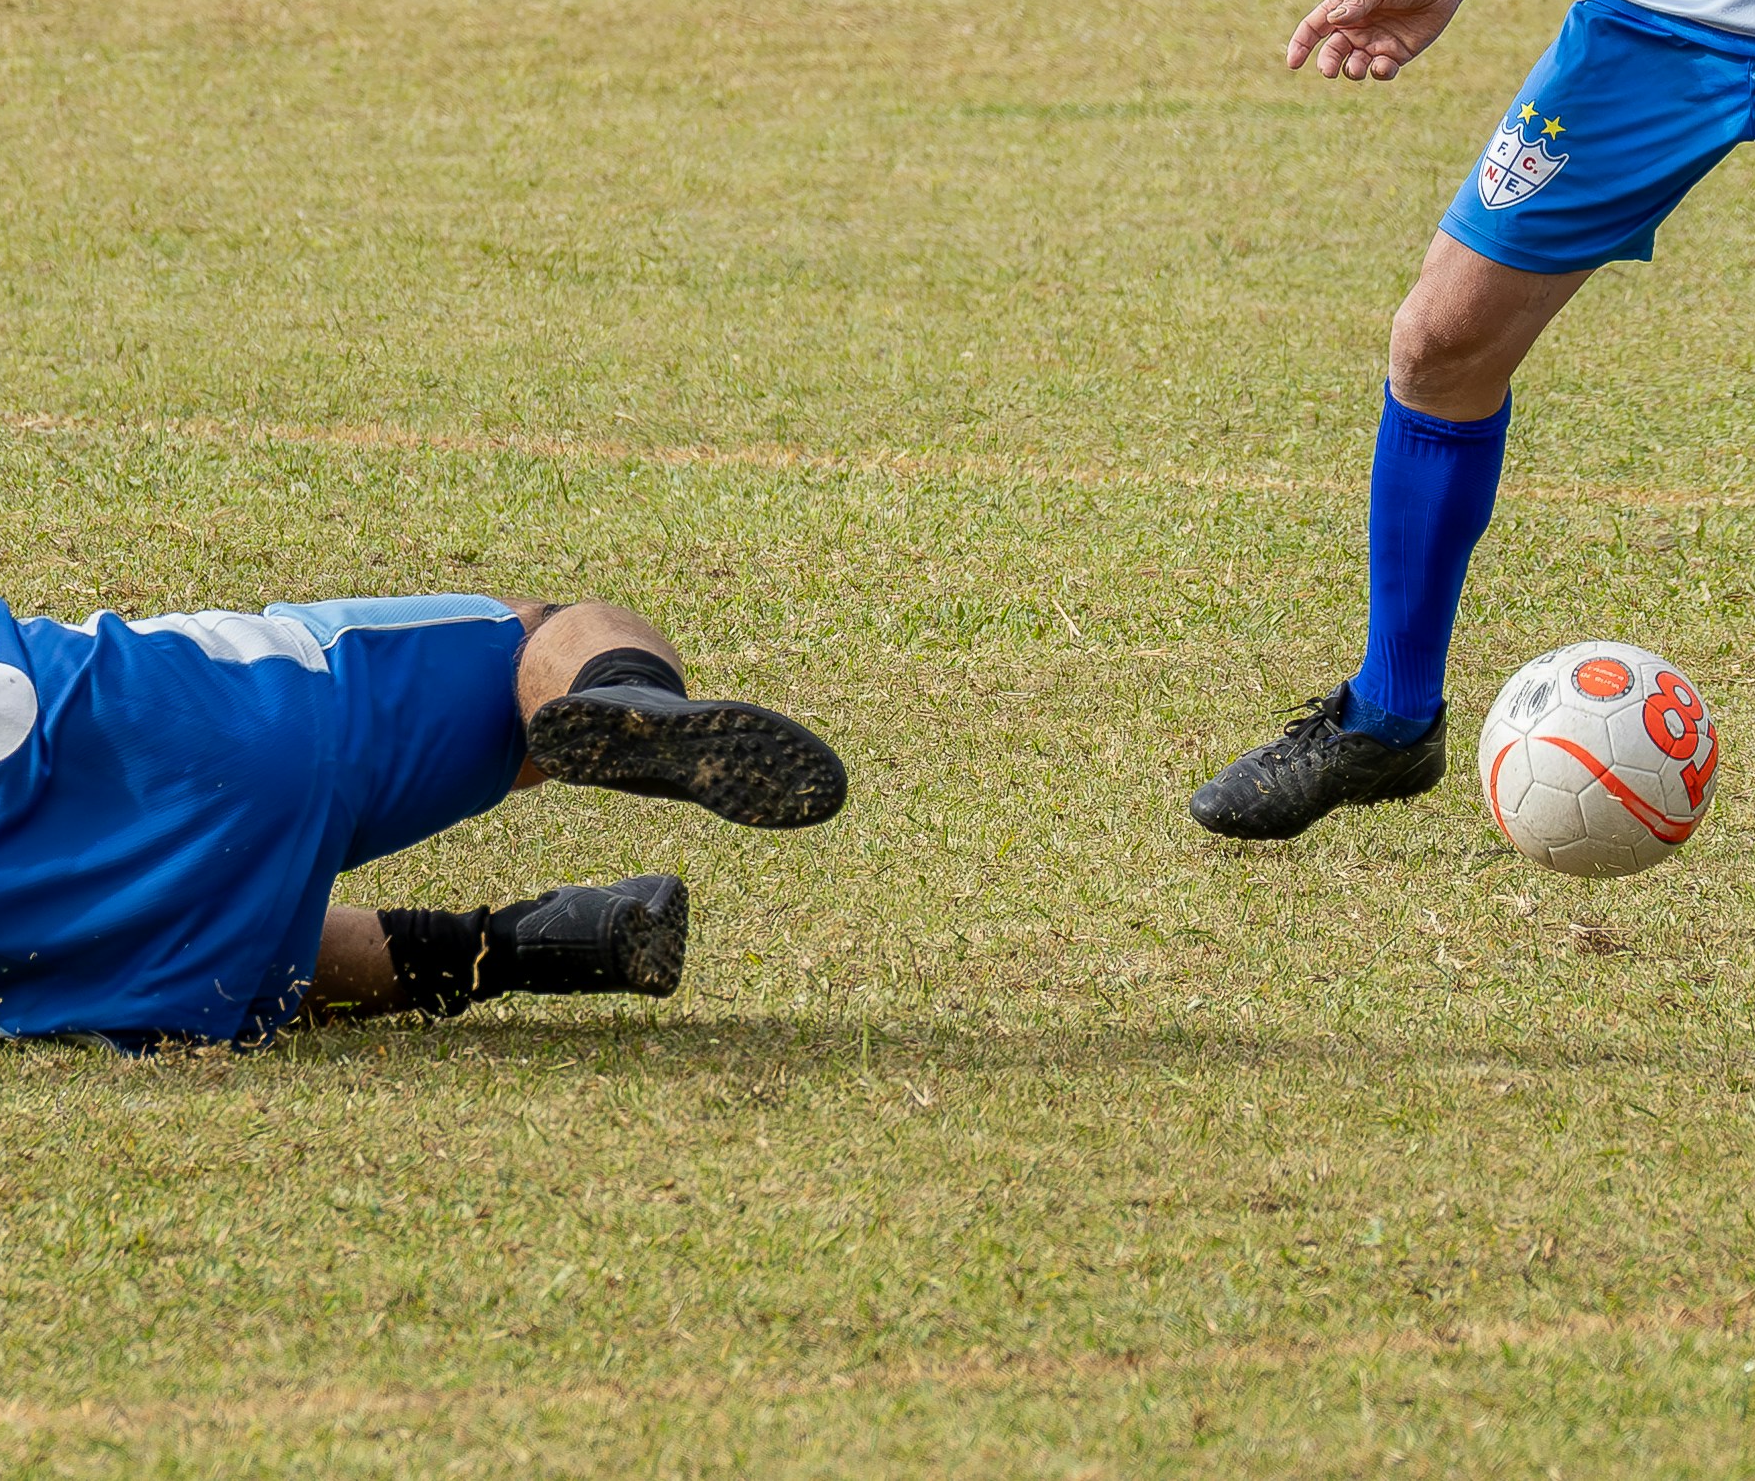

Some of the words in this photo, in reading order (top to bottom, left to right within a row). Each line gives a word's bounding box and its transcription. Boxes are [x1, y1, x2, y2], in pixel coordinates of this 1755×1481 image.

[1497, 141, 1509, 156] F.
[1522, 156, 1538, 175] C.
[1485, 165, 1499, 183] N.
[1504, 177, 1520, 196] E.
[1642, 670, 1719, 812] 81
